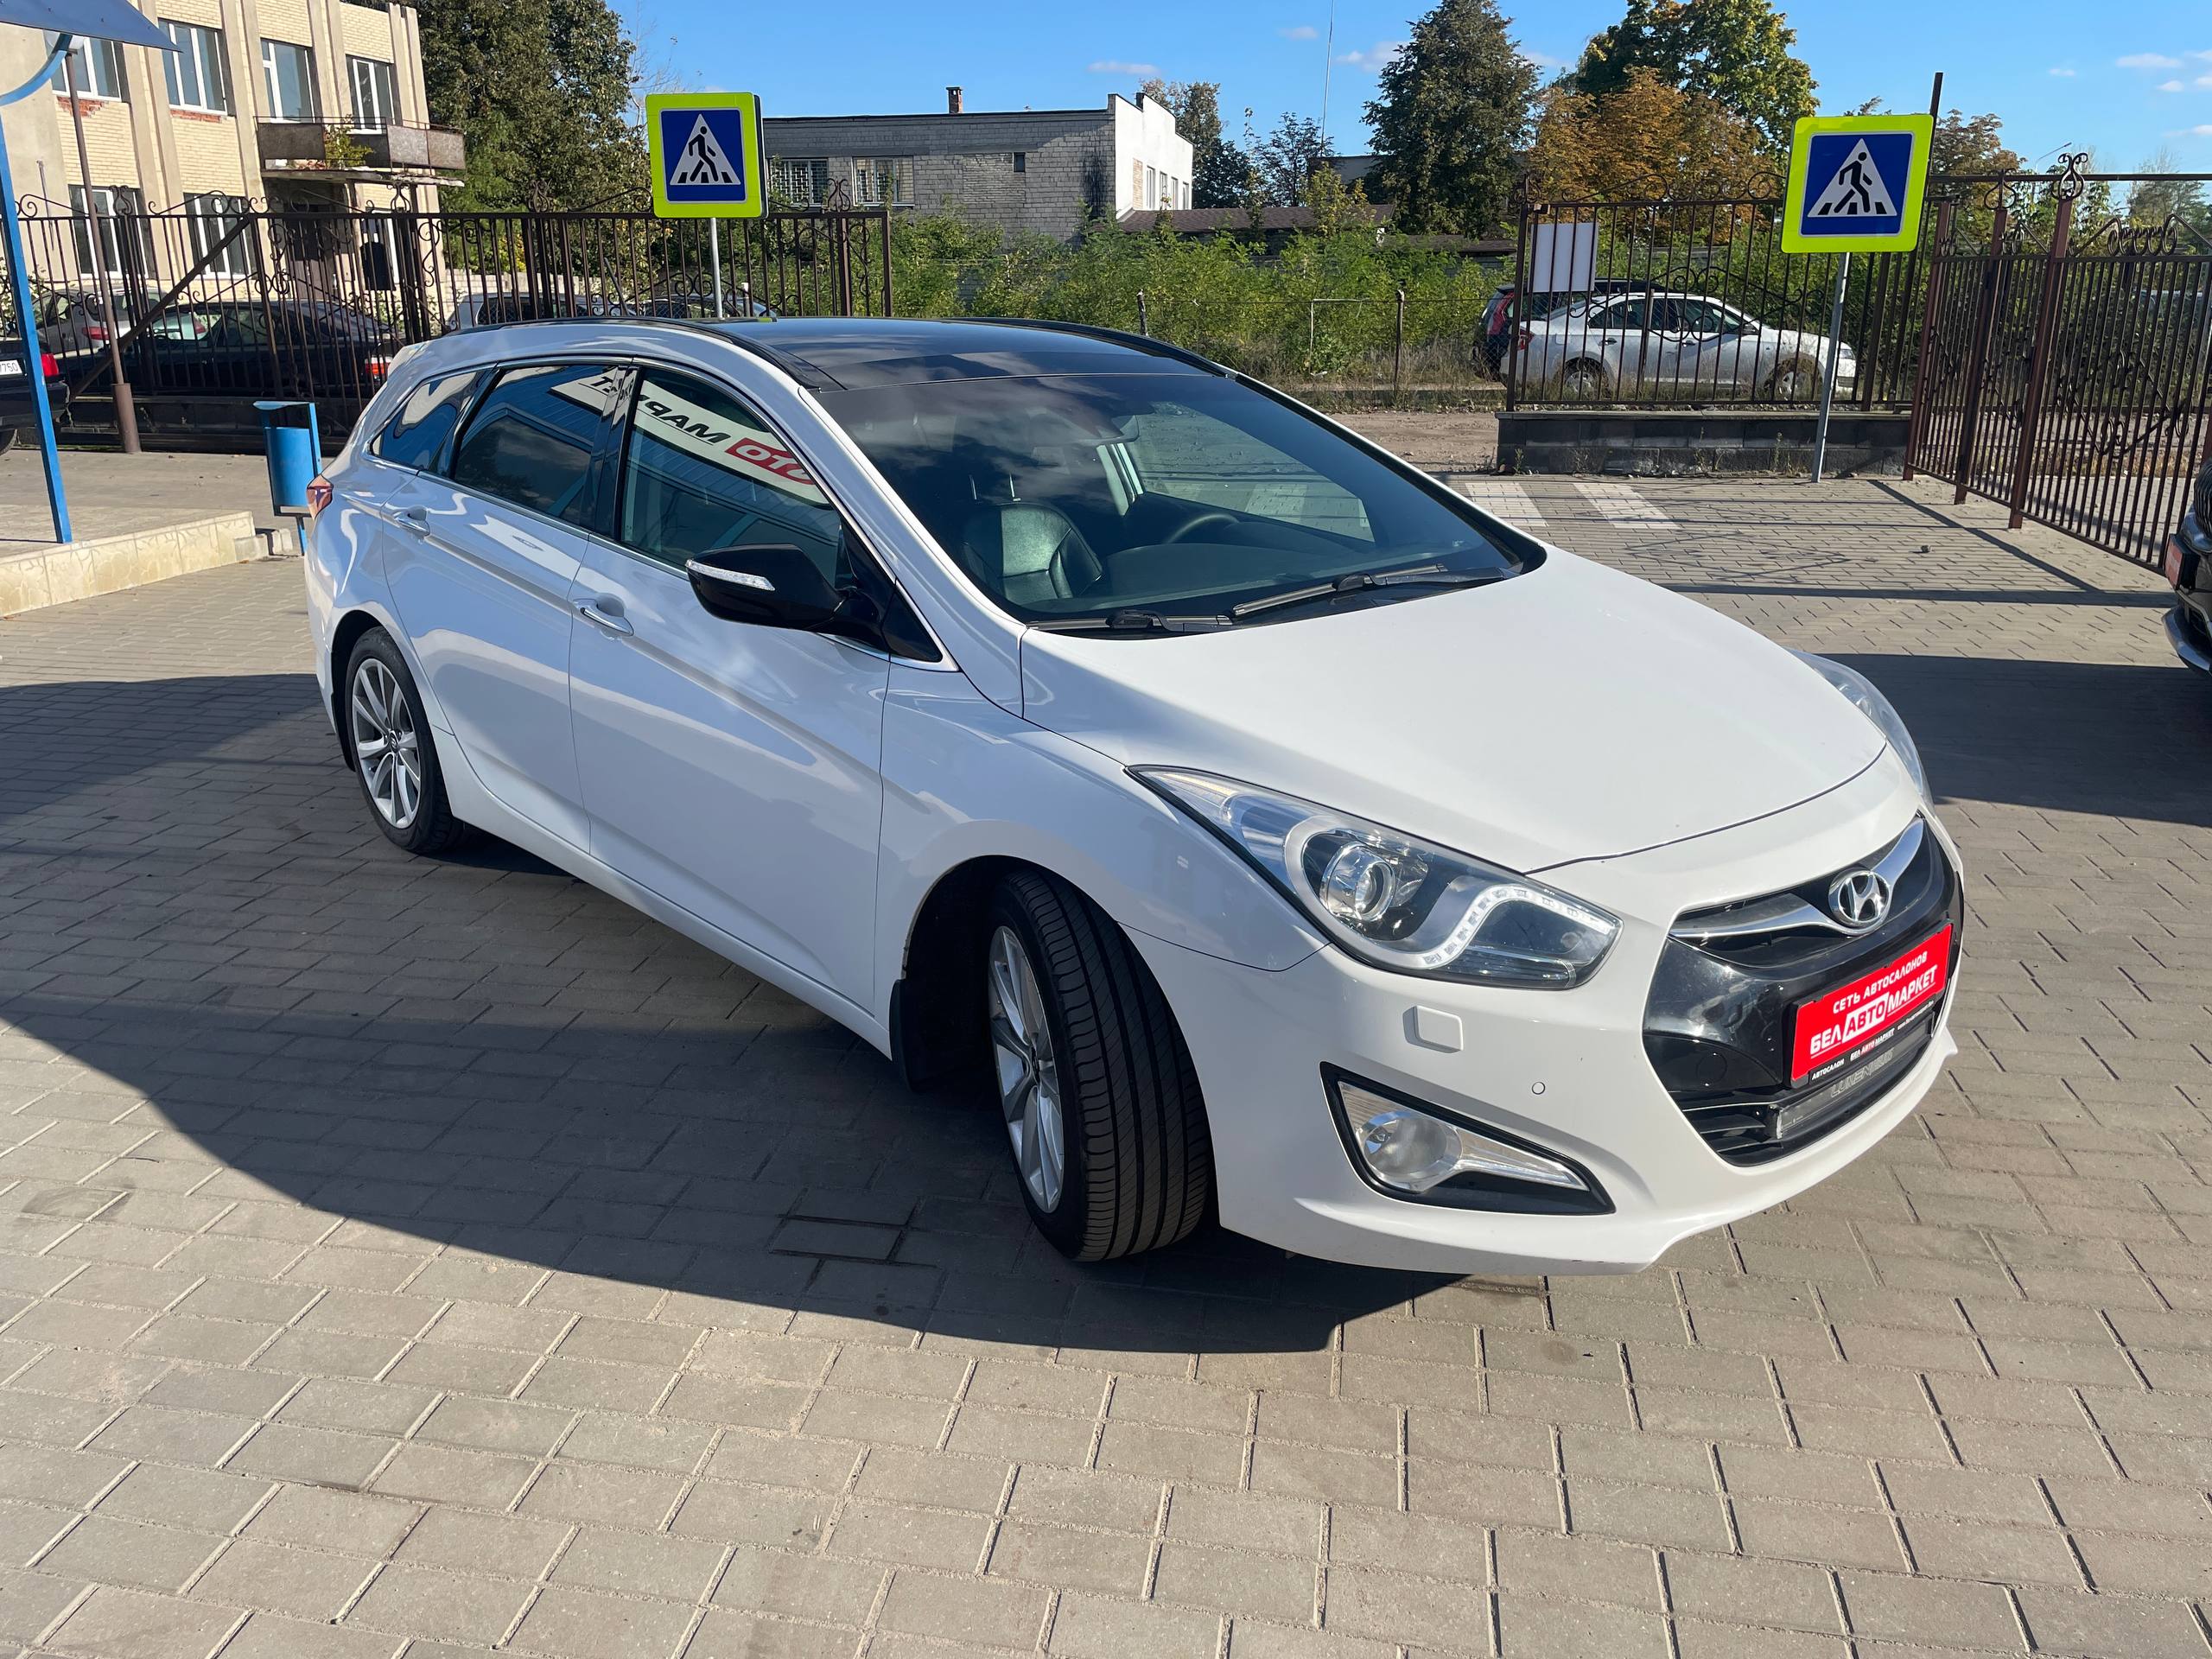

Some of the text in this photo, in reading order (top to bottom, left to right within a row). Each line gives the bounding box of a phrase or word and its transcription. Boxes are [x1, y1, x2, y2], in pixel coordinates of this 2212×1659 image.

[0, 362, 19, 372] 750
[1833, 950, 1929, 1014] СЕТЬ АВТОСАЛОНОВ
[1811, 1058, 1845, 1081] АВТОСАЛОН
